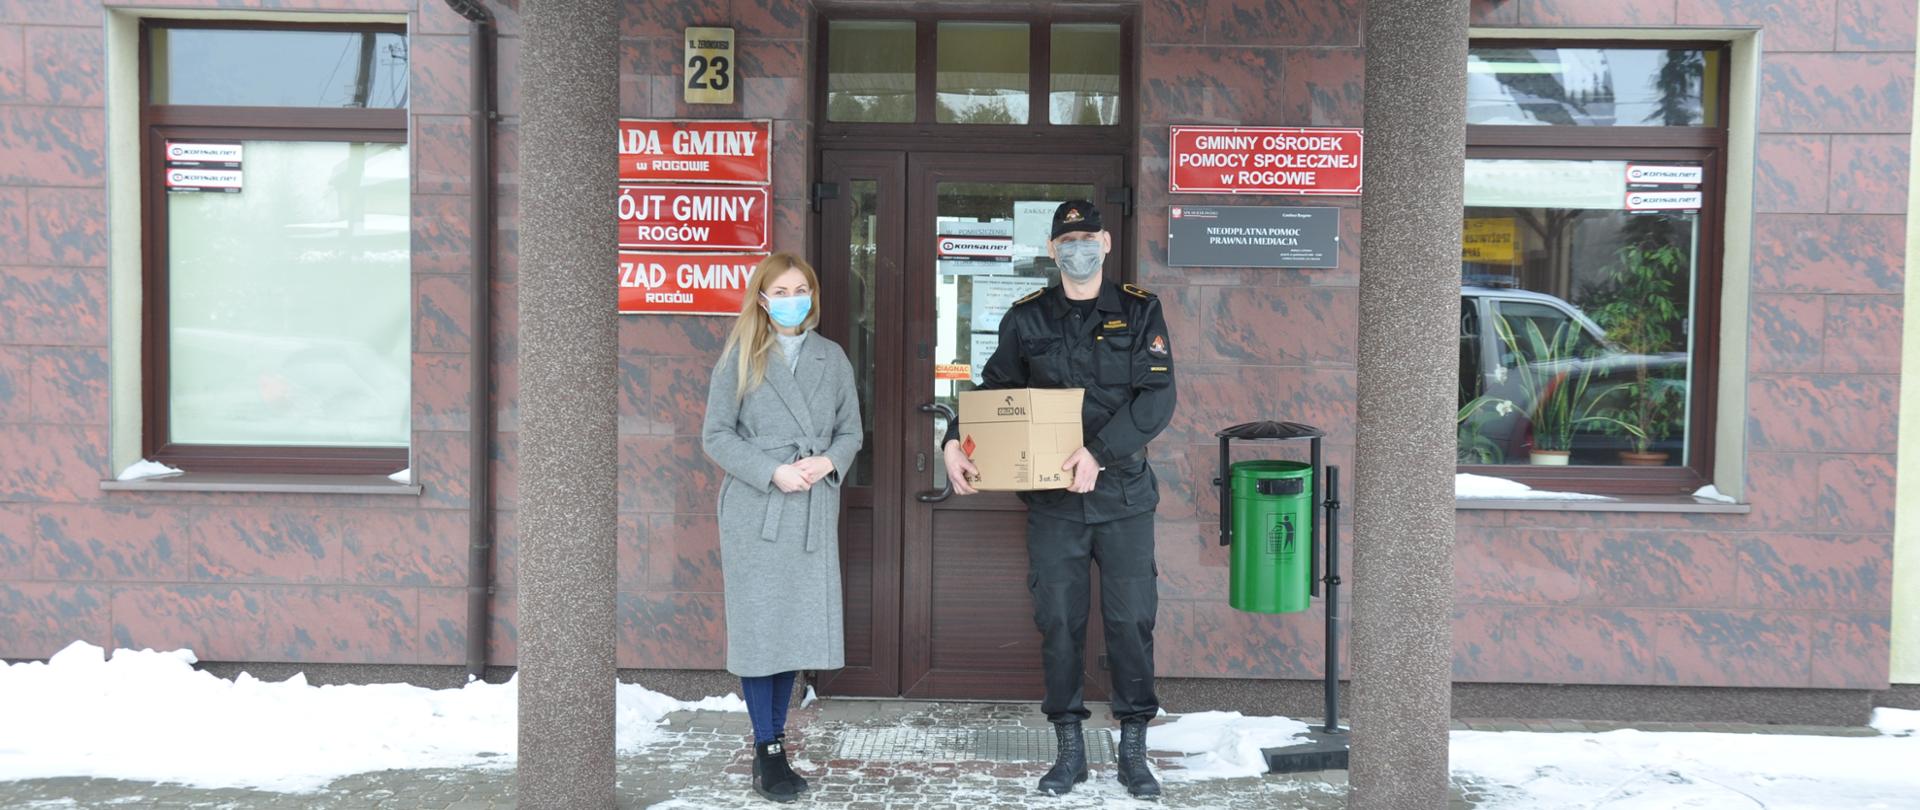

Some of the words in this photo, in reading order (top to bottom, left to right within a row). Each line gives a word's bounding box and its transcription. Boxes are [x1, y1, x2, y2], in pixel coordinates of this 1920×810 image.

[688, 55, 730, 91] 23
[672, 130, 757, 156] GMINY
[1195, 136, 1258, 150] GMINNY
[1263, 134, 1342, 151] OŚRODEK
[652, 160, 710, 172] ROGOWIE
[1179, 153, 1249, 167] POMOCY
[1254, 154, 1357, 168] SPOŁECZNEJ
[1221, 174, 1233, 185] w
[1238, 171, 1316, 186] ROGOWIE
[619, 189, 665, 220] ÓJT
[672, 196, 756, 222] GMINY
[638, 224, 710, 241] ROGÓW
[1269, 228, 1301, 237] POMOC
[1209, 236, 1247, 245] PRAWNA
[1253, 237, 1298, 246] MEDIACJA
[618, 263, 666, 290] ZĄD
[676, 264, 757, 289] GMINY
[646, 291, 693, 303] ROGÓW
